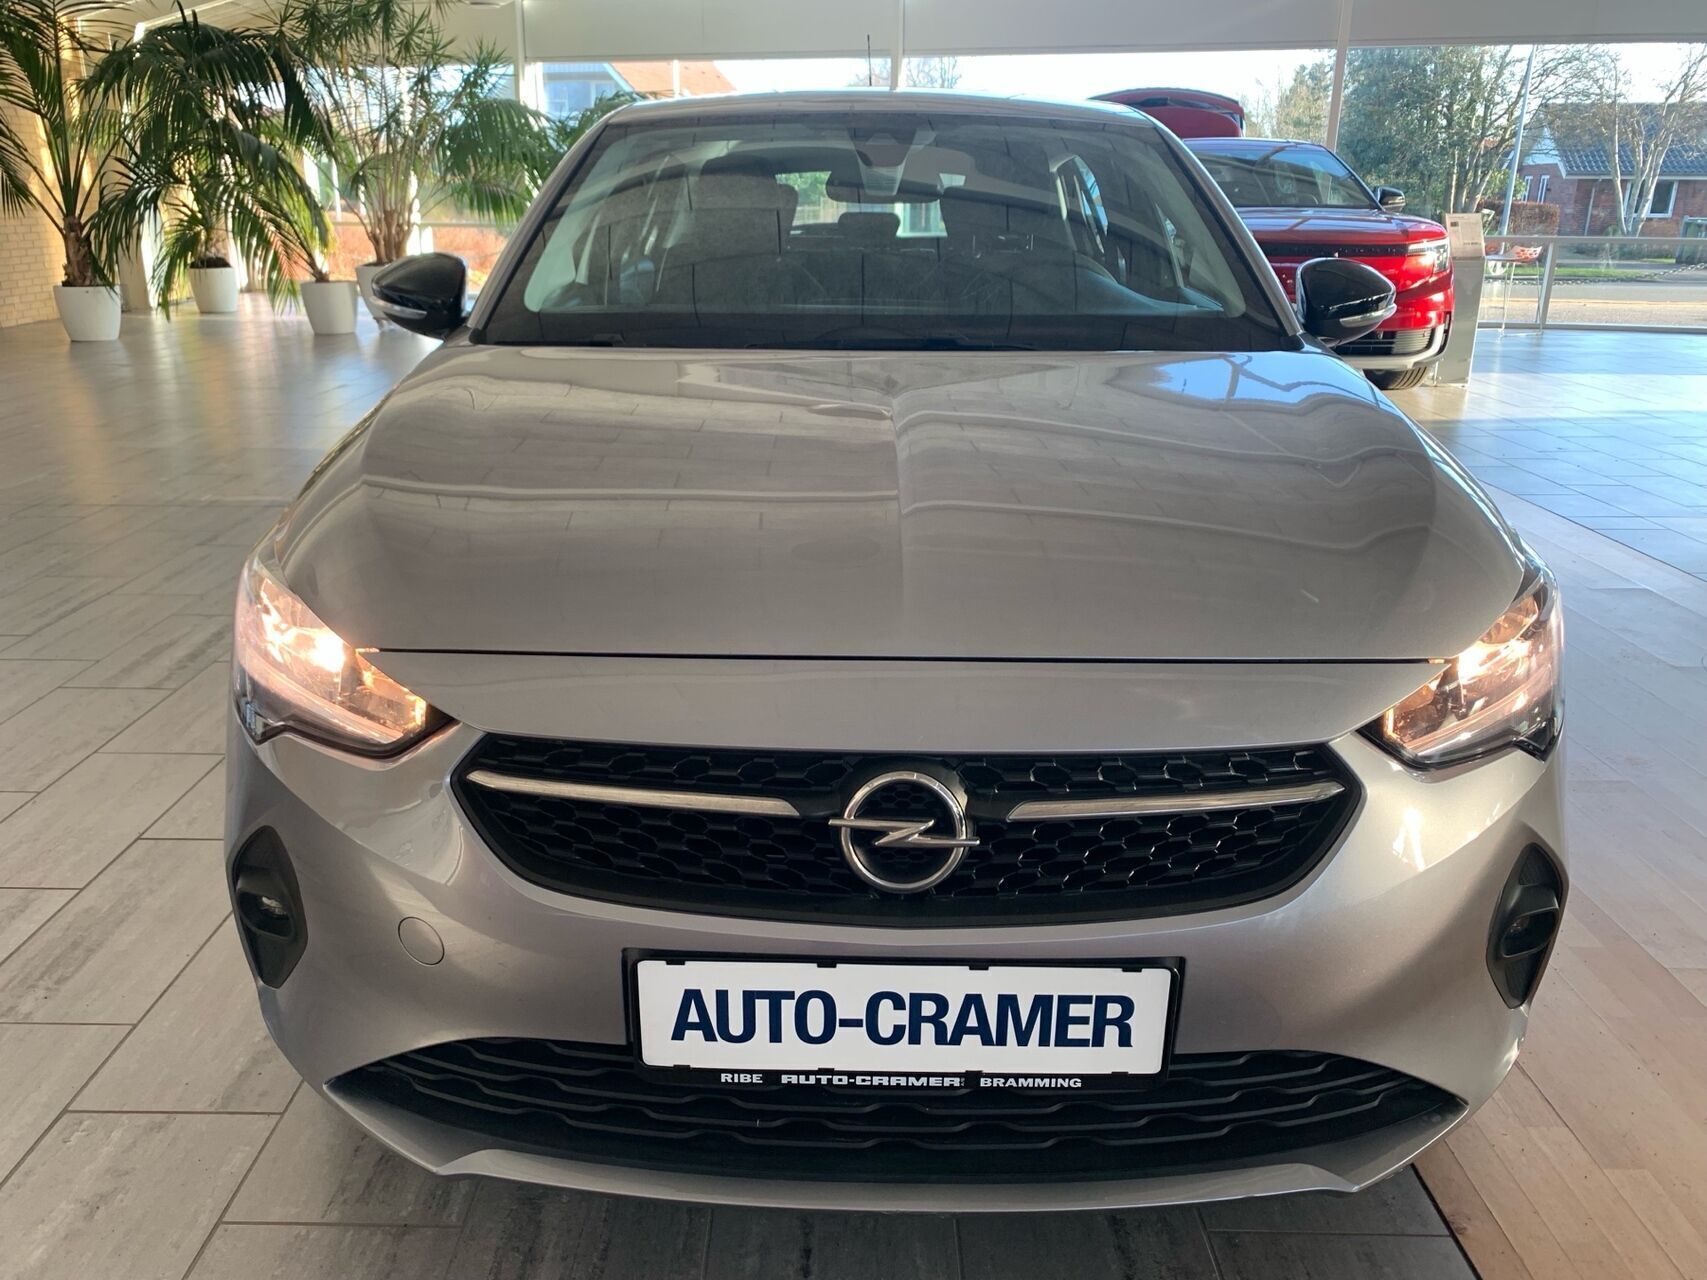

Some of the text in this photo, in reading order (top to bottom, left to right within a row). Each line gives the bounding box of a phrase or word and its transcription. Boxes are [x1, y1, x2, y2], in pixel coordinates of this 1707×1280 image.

[671, 988, 1135, 1048] AUTO-CRAMER
[720, 1073, 764, 1084] RIBE
[780, 1074, 961, 1087] AUTO-CRAMER
[979, 1077, 1083, 1088] BRAMMING
